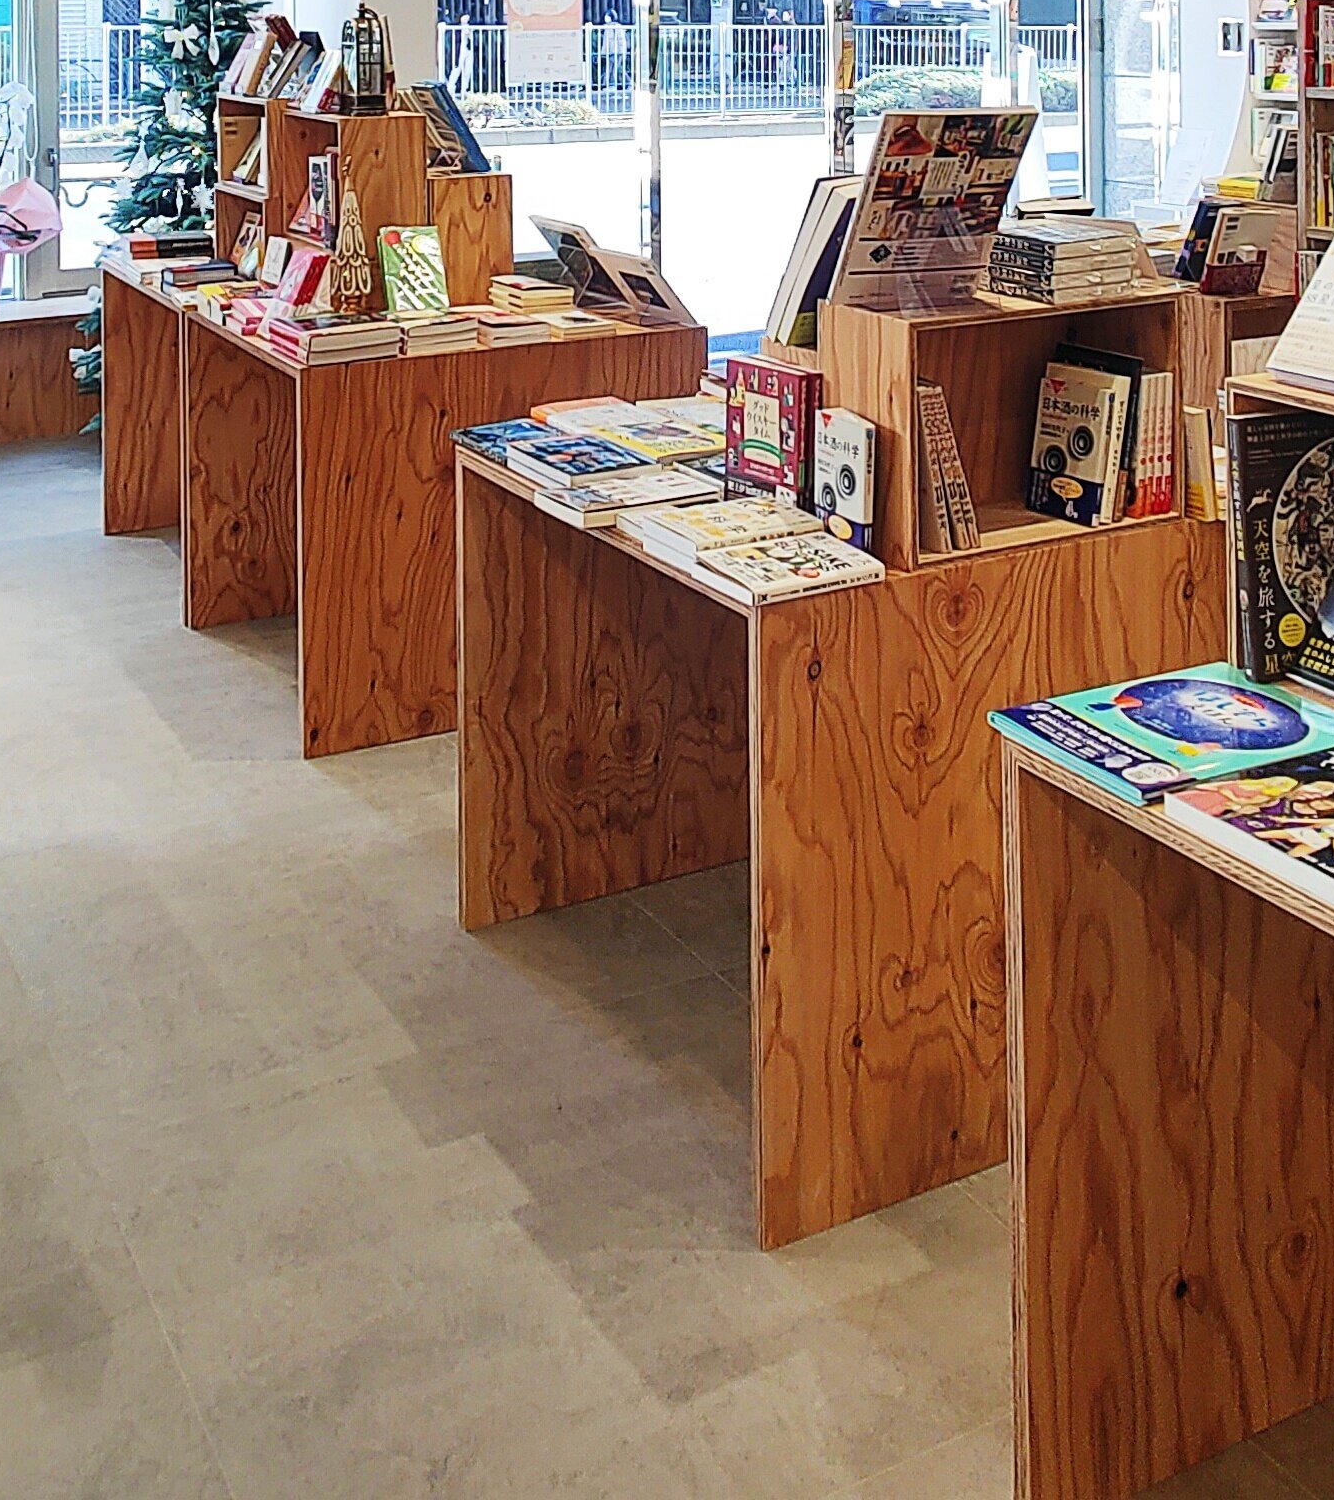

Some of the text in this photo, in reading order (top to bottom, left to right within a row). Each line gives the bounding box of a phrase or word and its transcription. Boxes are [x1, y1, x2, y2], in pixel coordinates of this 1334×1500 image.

[753, 401, 770, 413] グッド
[1041, 397, 1102, 422] 日本酒の科学
[747, 411, 777, 427] ウイスキー
[753, 427, 771, 439] タイム
[817, 431, 860, 460] 日本酒の科学
[1253, 518, 1277, 651] 天空を旅する
